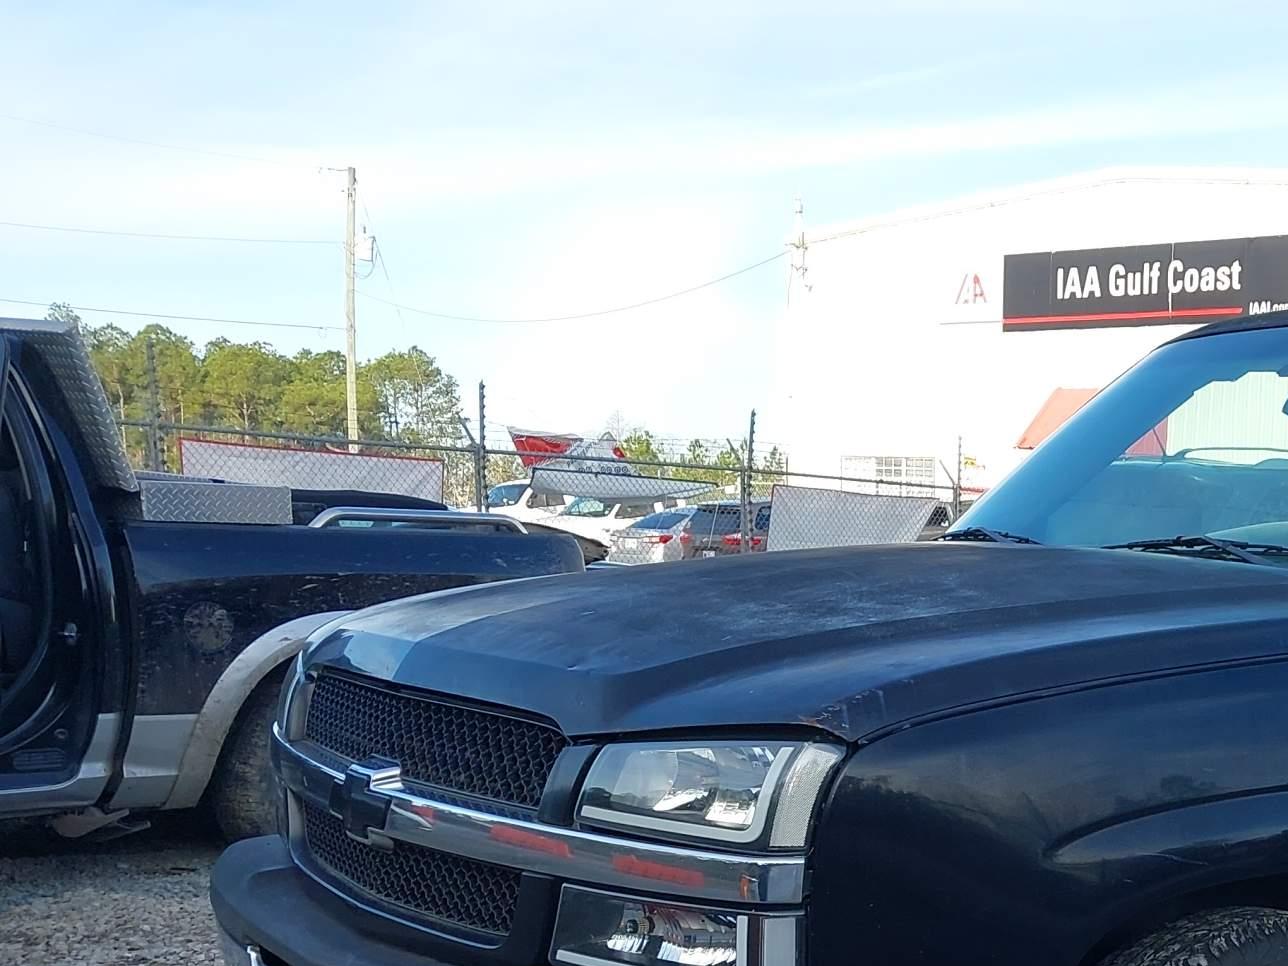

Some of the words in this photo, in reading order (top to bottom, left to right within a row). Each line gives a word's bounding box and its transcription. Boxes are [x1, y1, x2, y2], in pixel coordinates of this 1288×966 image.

[1056, 266, 1101, 300] IAA
[1108, 261, 1160, 297] Gulf
[1168, 260, 1242, 294] Coast
